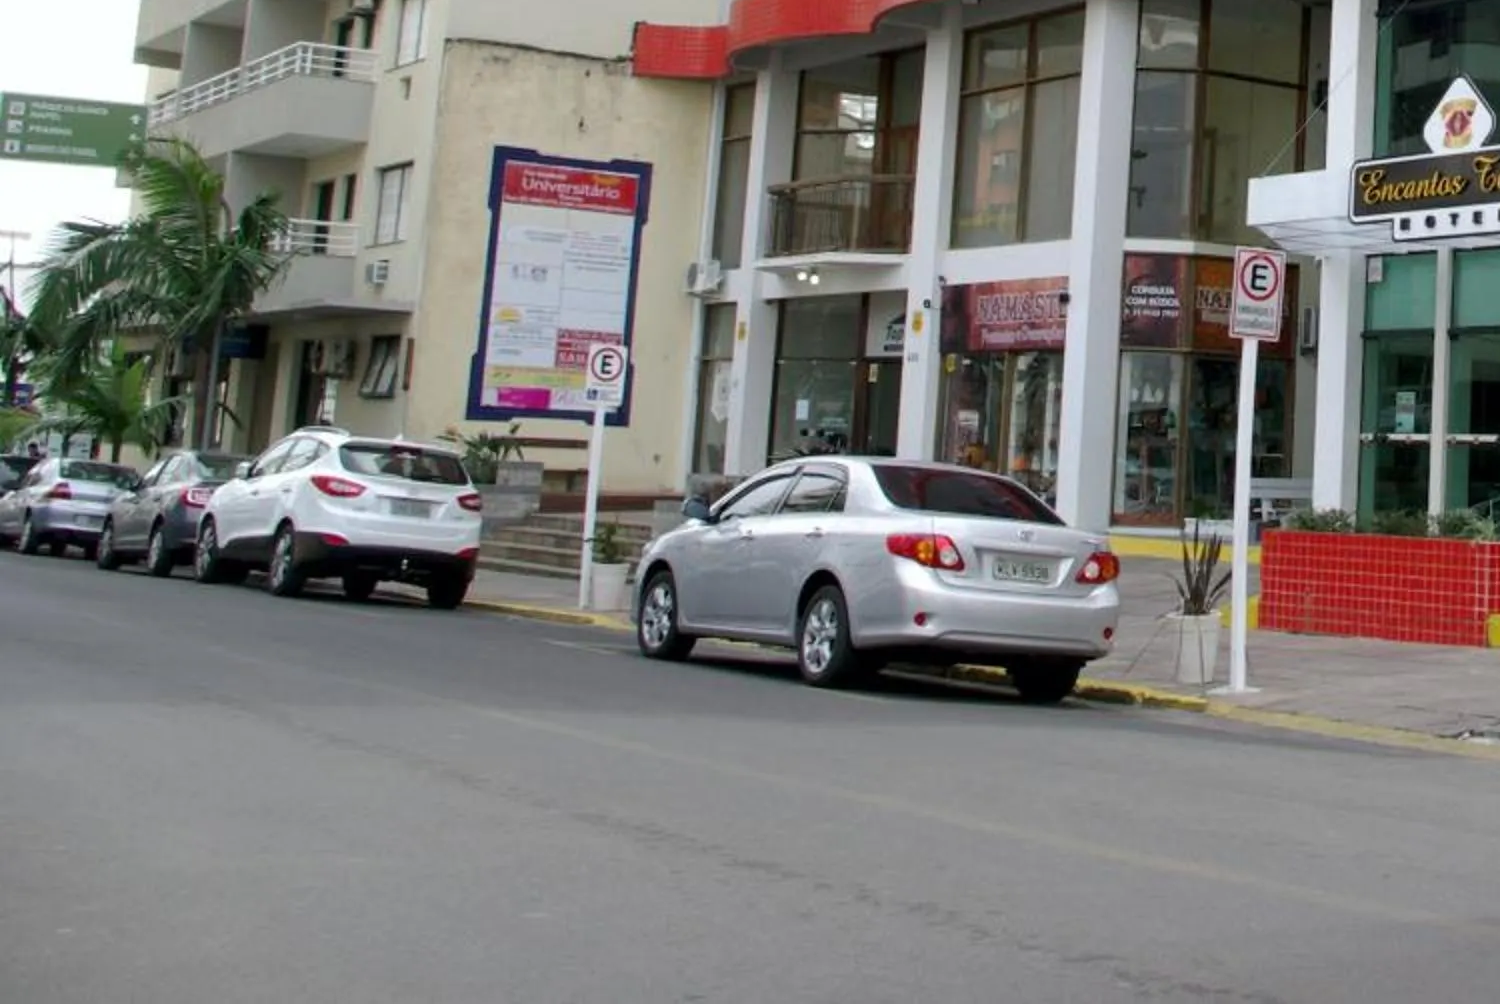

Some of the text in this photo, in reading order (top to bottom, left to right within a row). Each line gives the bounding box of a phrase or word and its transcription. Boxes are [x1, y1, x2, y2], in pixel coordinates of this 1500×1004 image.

[521, 176, 621, 200] Universitário
[1359, 168, 1466, 205] Encantos
[1250, 263, 1269, 292] E
[600, 353, 615, 375] E
